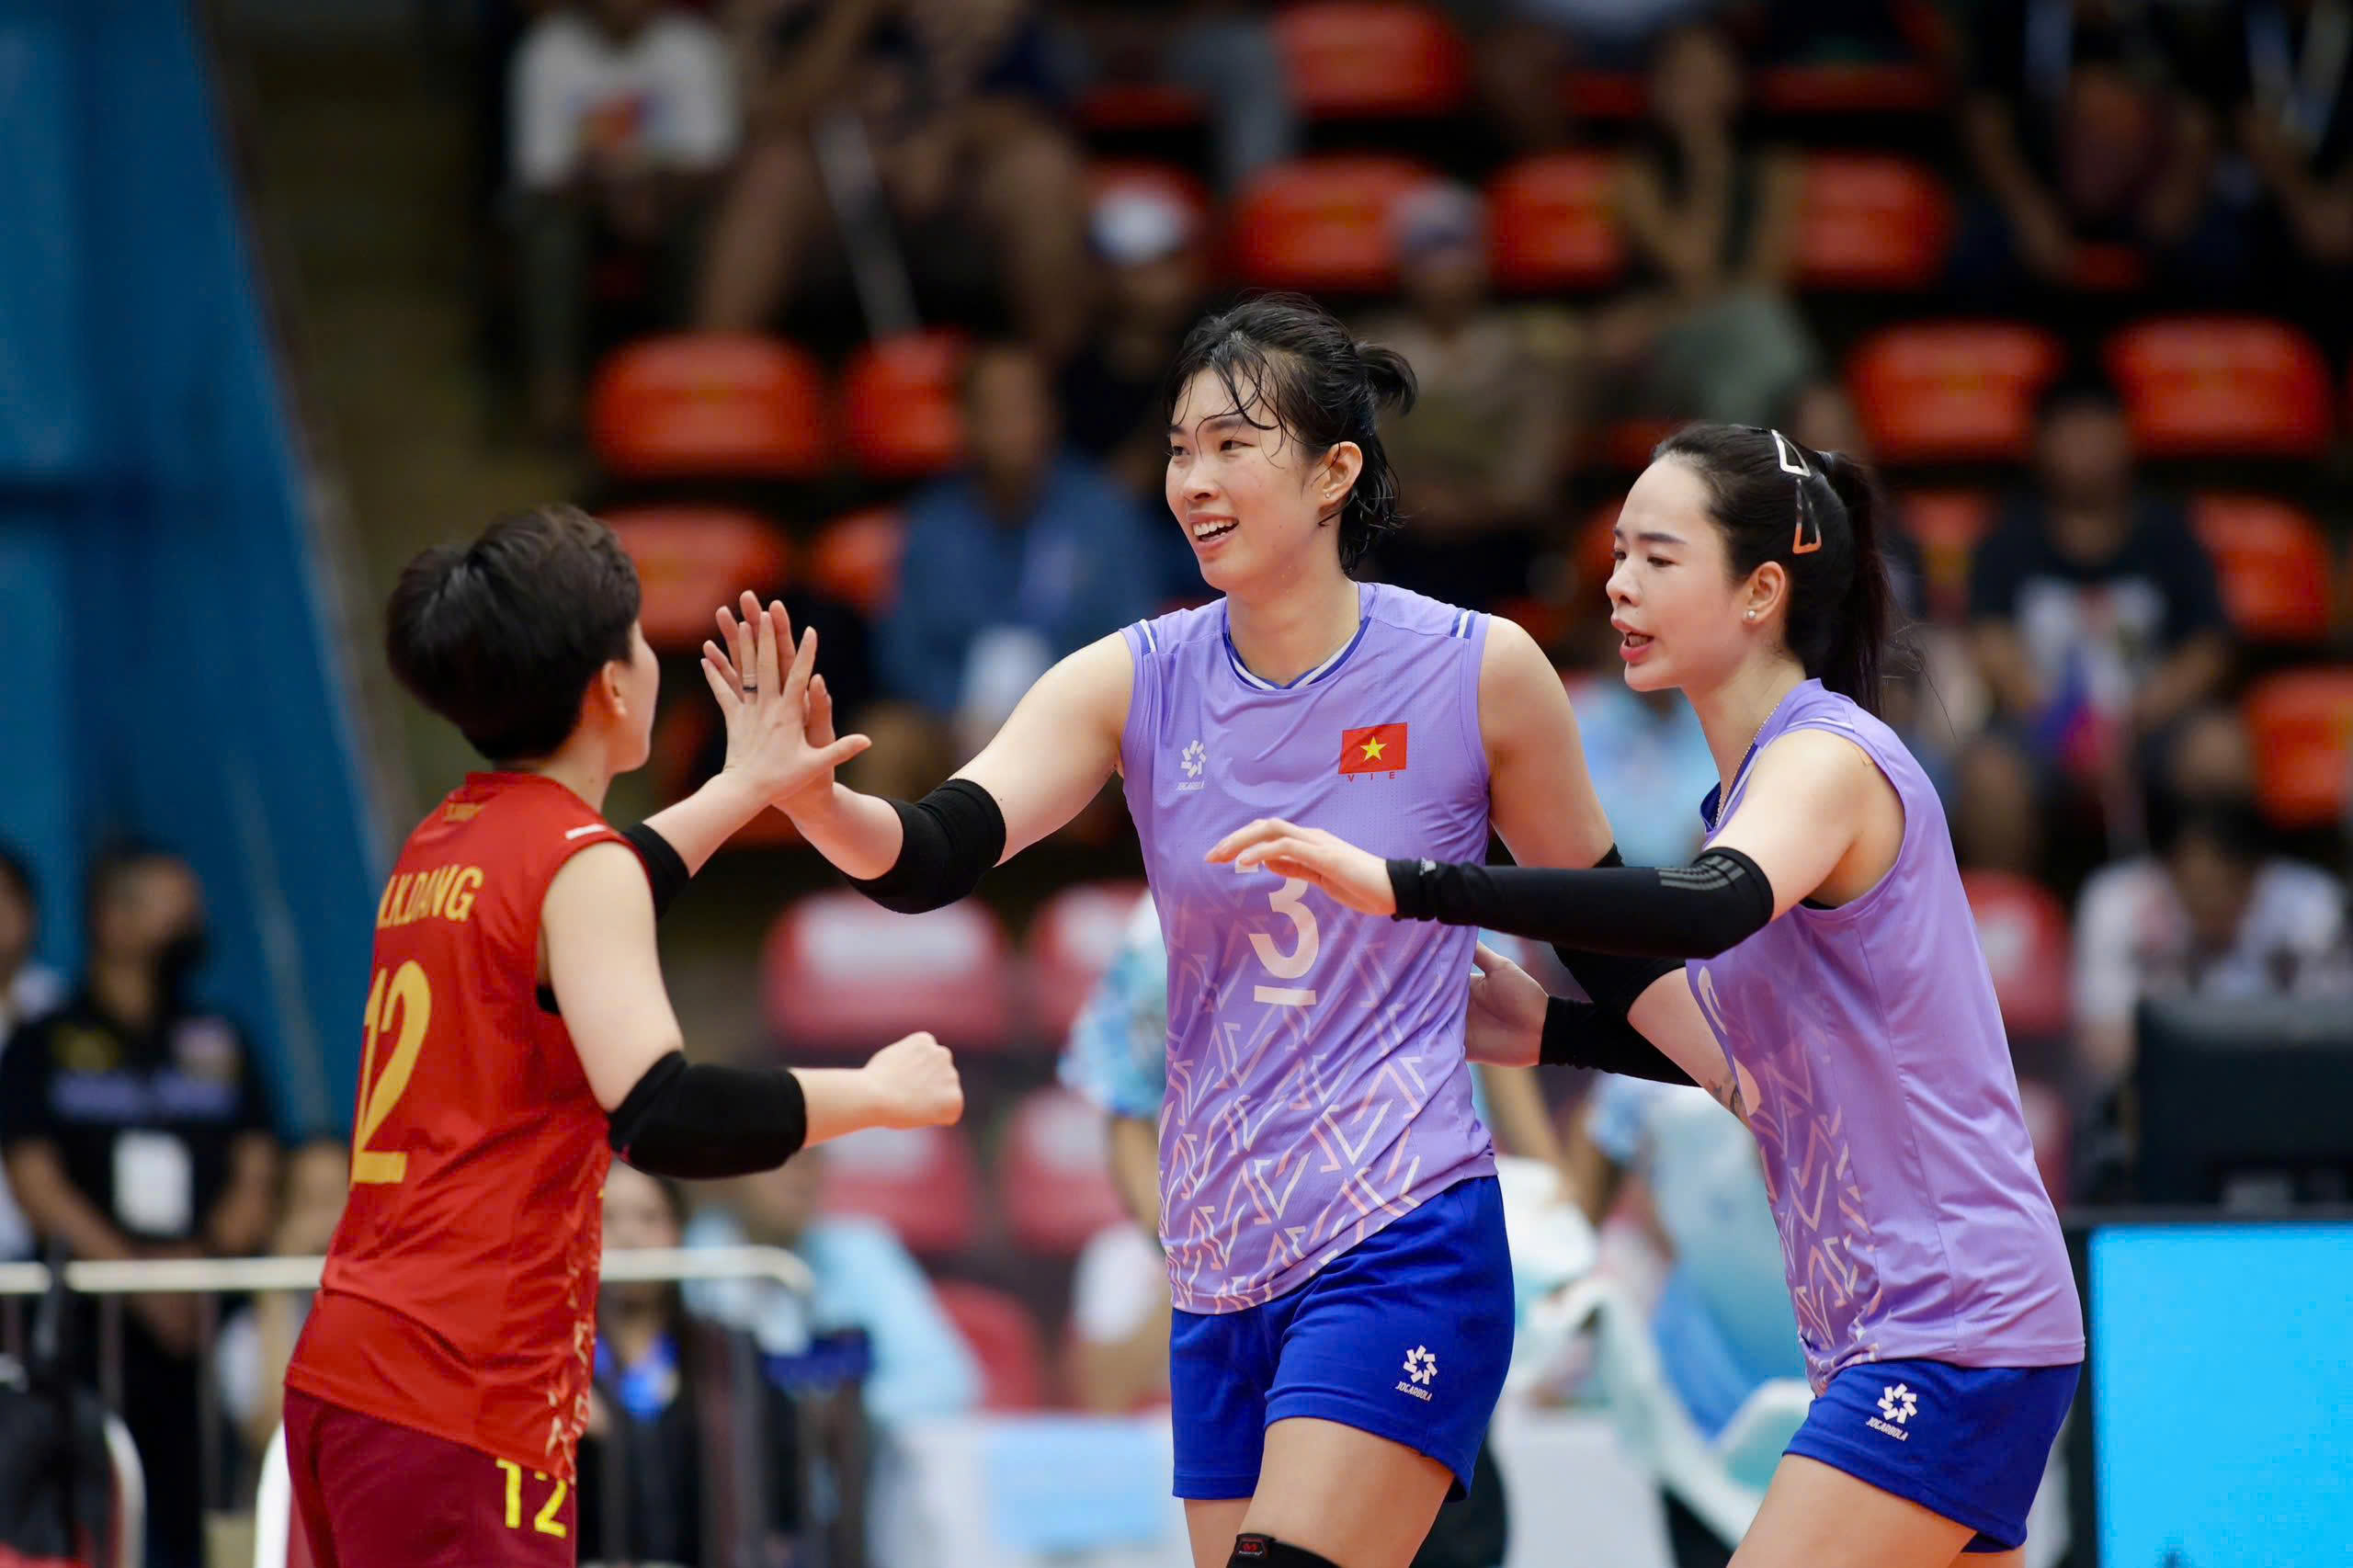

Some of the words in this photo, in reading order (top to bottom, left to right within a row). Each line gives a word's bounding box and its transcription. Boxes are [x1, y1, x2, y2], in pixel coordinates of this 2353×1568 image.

[1347, 770, 1396, 782] VIE
[1235, 855, 1320, 979] 3
[350, 960, 432, 1189] 12
[495, 1458, 568, 1540] 12
